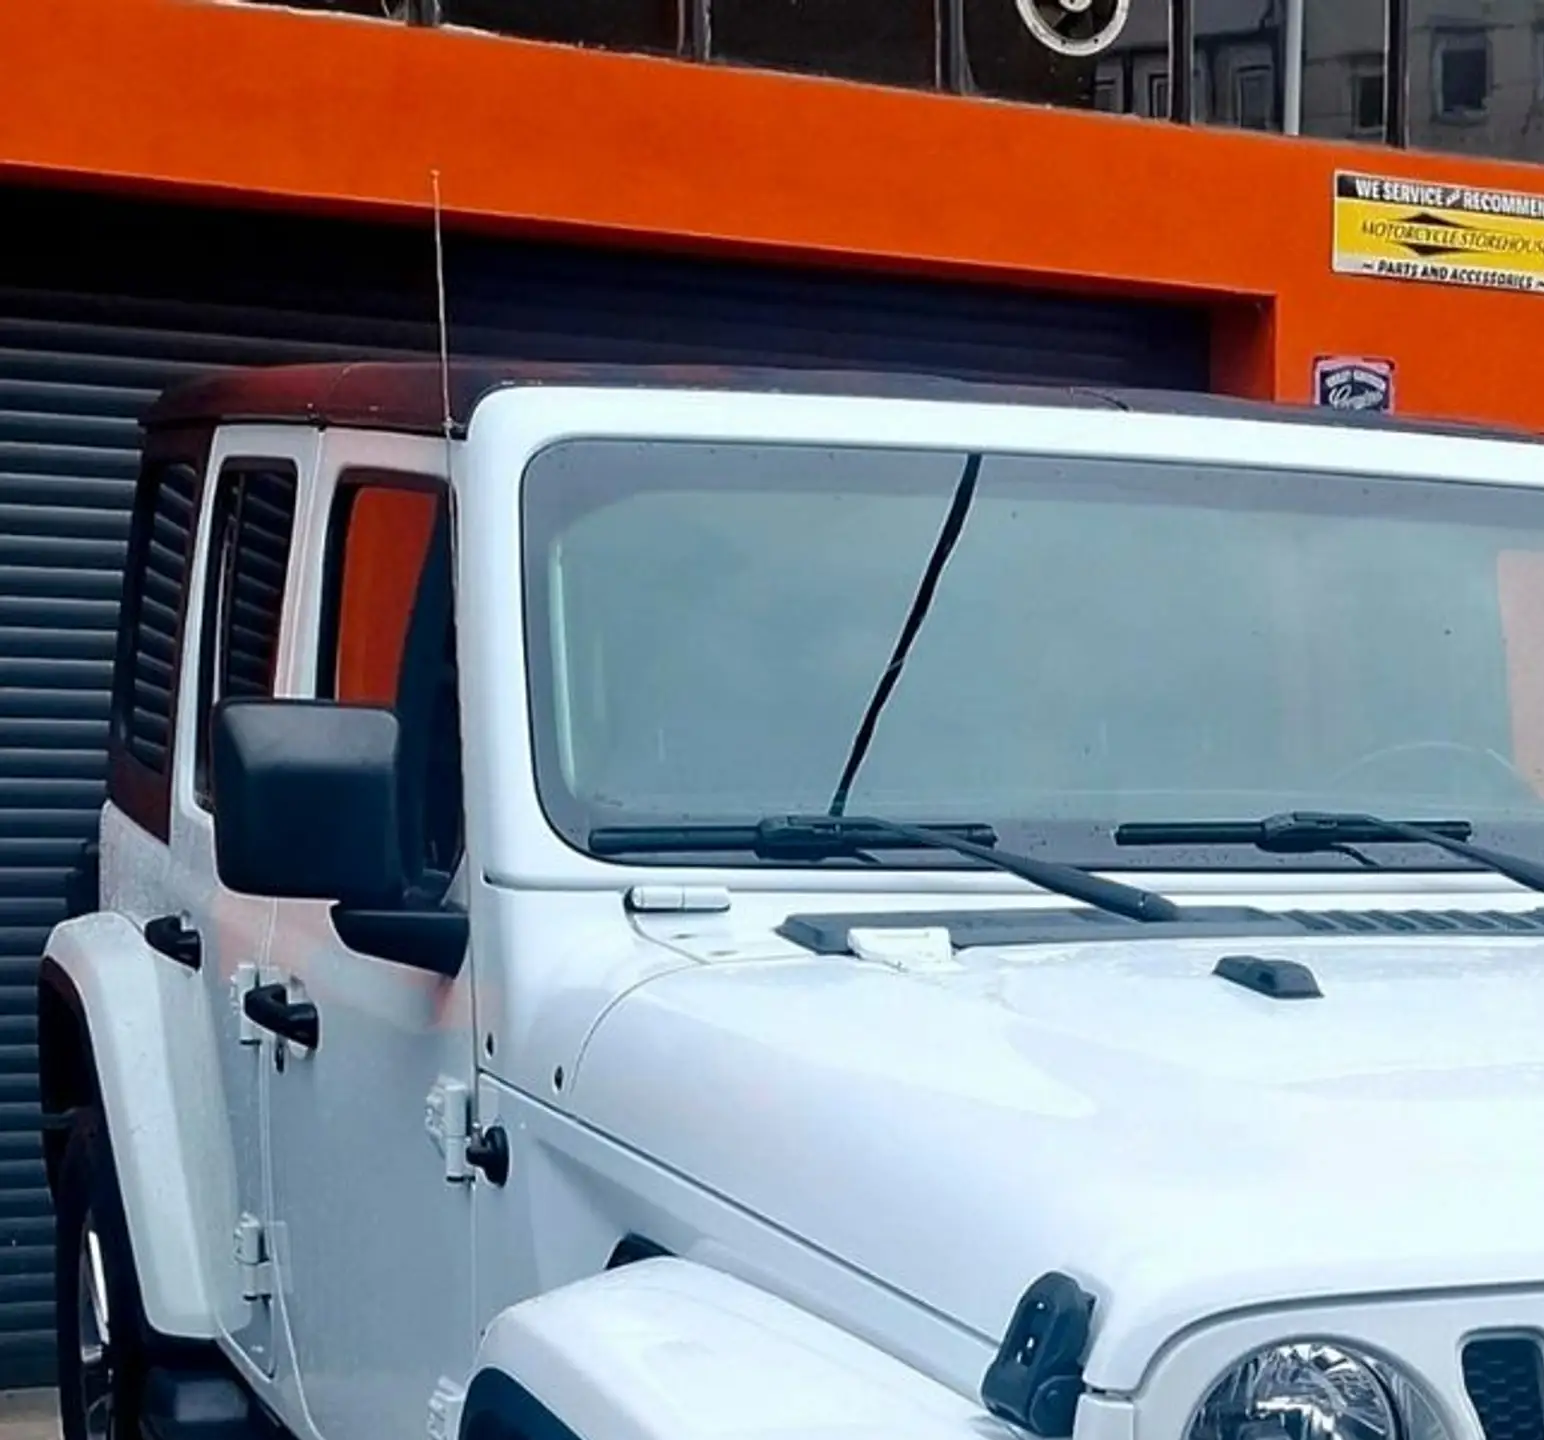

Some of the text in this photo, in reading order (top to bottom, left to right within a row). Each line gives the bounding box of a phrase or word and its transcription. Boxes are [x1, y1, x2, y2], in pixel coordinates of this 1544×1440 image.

[1355, 178, 1382, 199] WE
[1383, 184, 1444, 205] SERVICE
[1362, 219, 1456, 245] MOTORCYCLE
[1377, 259, 1532, 289] PARTS AND ACCESSORIES
